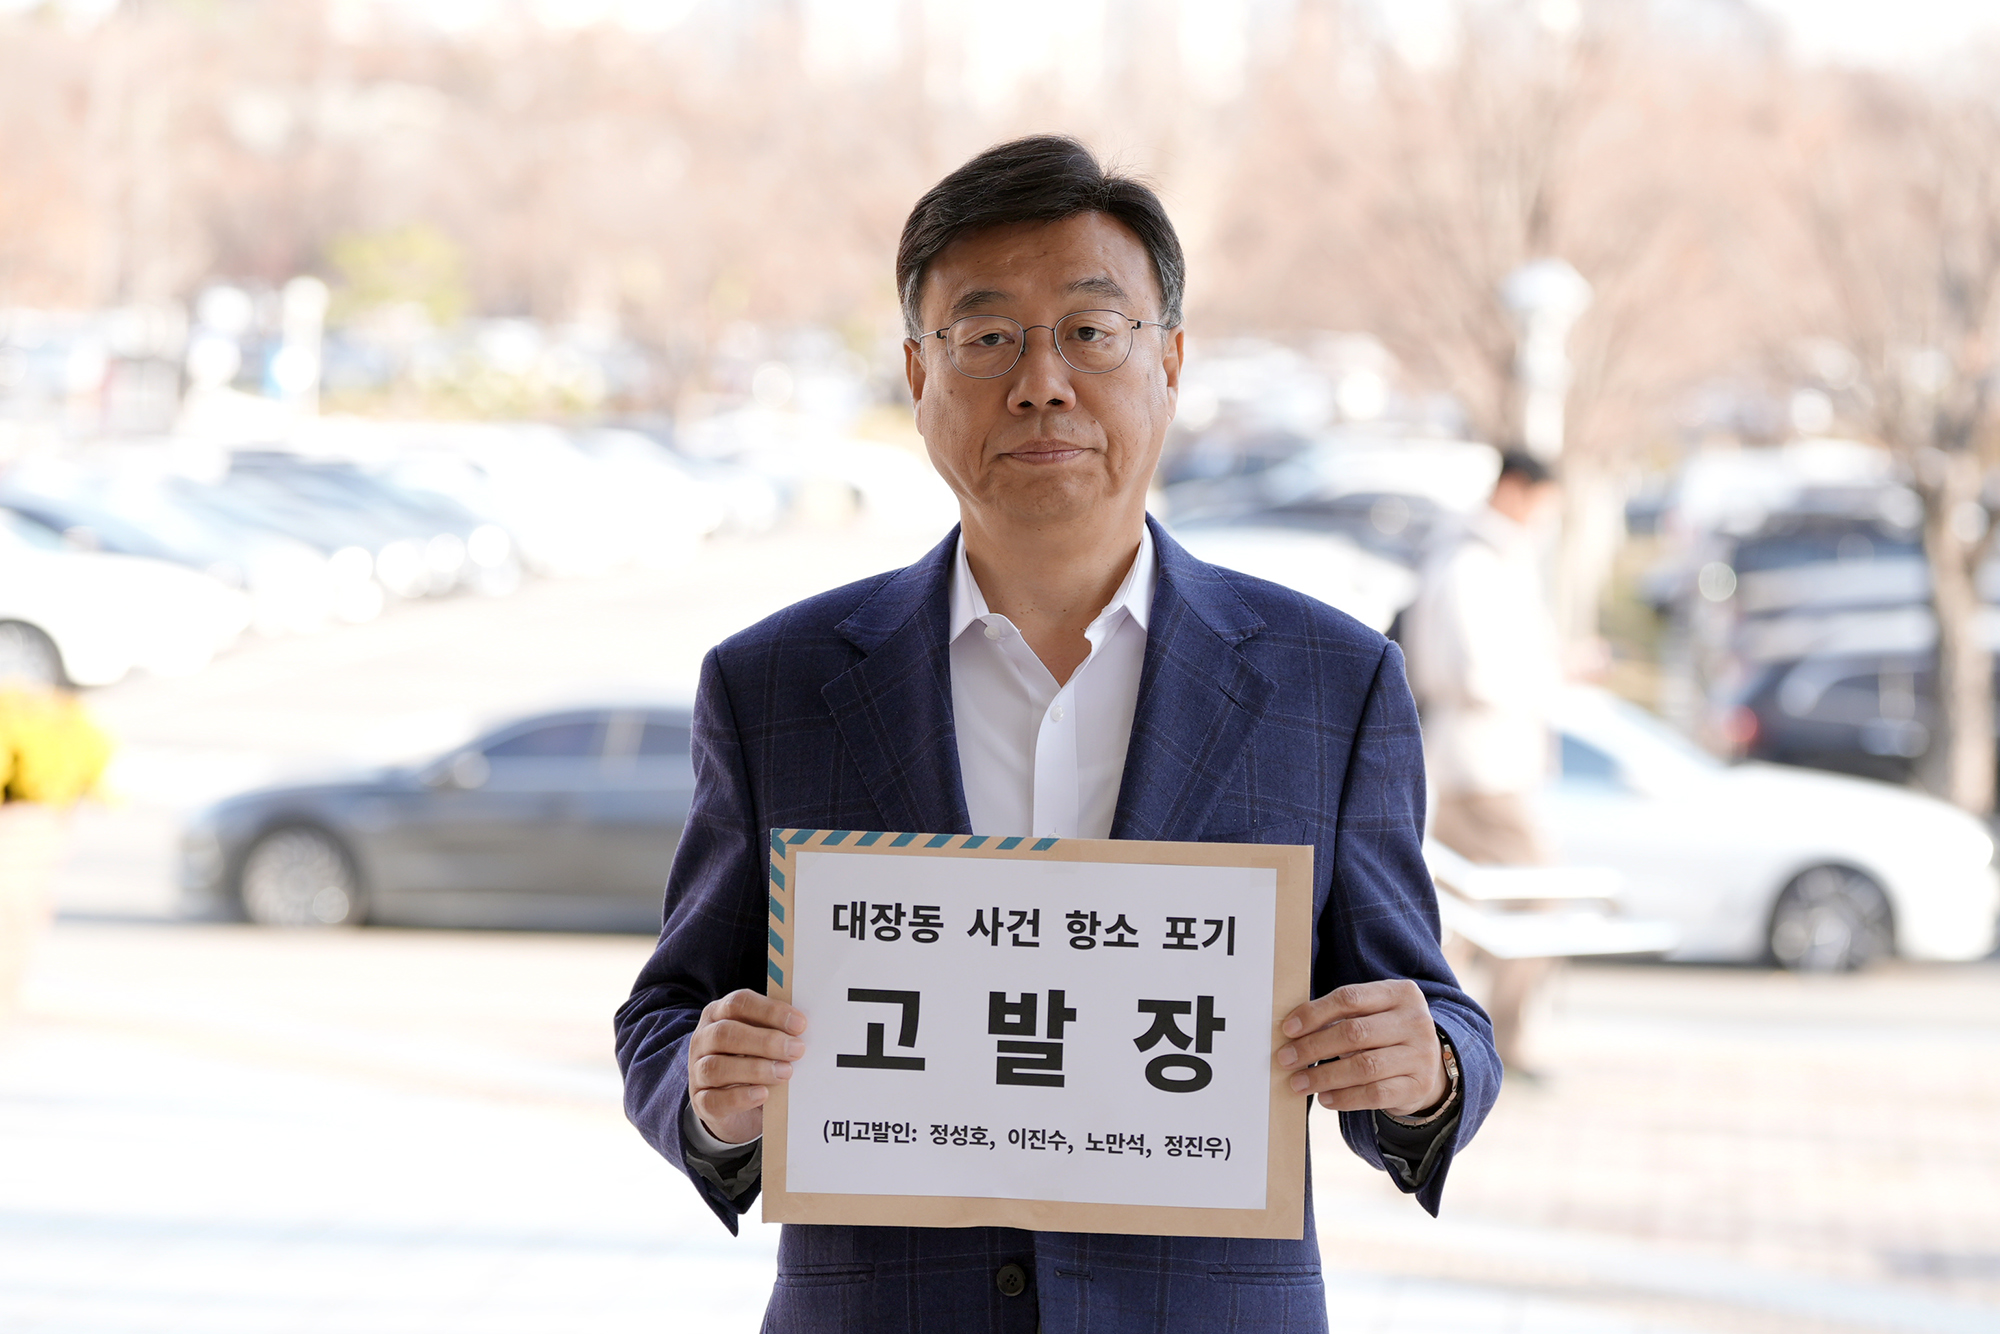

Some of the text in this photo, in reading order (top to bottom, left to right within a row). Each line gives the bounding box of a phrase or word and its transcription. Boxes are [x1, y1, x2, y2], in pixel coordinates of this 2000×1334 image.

[833, 901, 1235, 956] 대장동 사건 항소 포기
[824, 1120, 1230, 1161] (피고발인: 정성호, 이진수, 노만석, 정진우)
